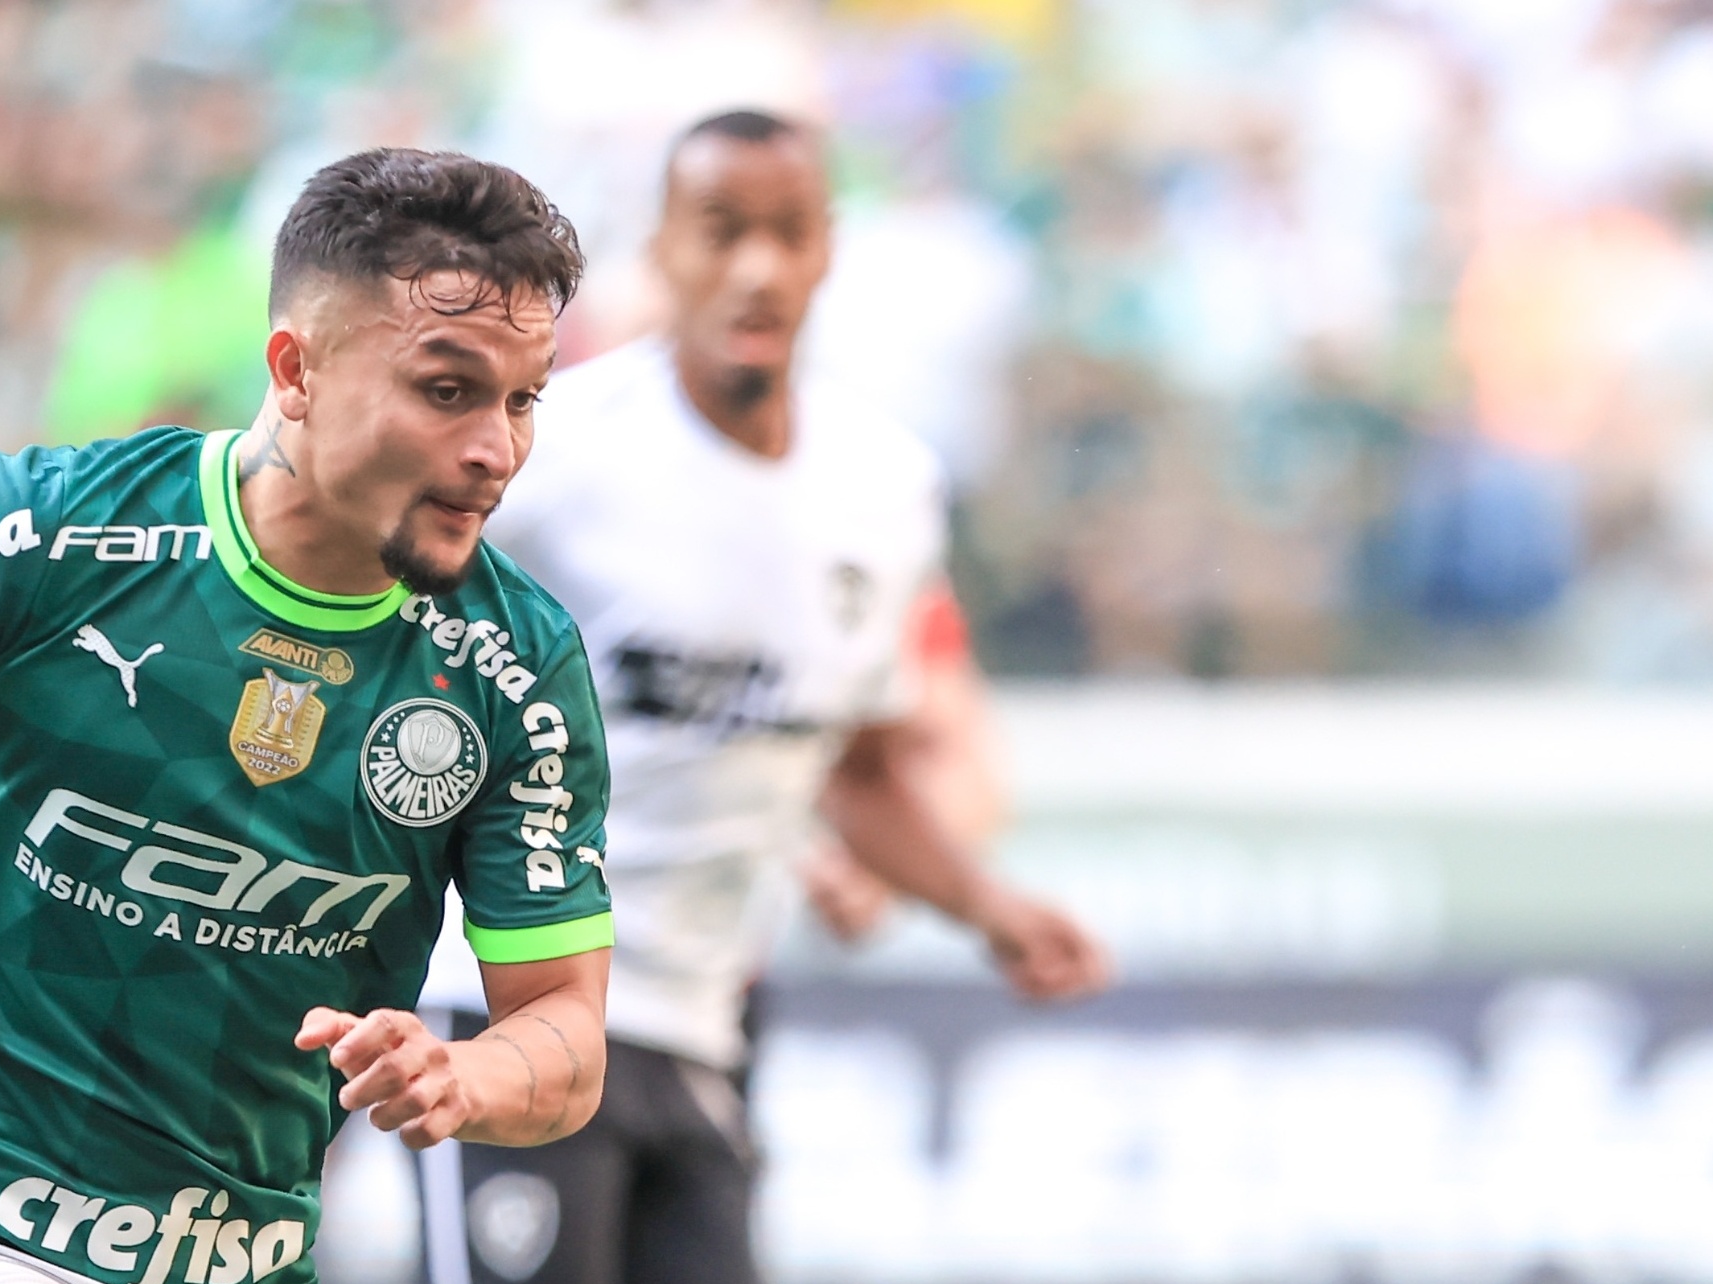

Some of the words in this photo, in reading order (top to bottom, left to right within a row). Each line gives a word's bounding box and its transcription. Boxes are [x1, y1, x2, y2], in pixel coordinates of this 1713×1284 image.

[250, 634, 319, 669] AVANTI
[248, 757, 281, 775] 2022
[369, 745, 477, 818] PALMEIRAS
[14, 842, 144, 927] ENSINO
[153, 912, 182, 941] A
[194, 919, 368, 959] DISTÂNCIA
